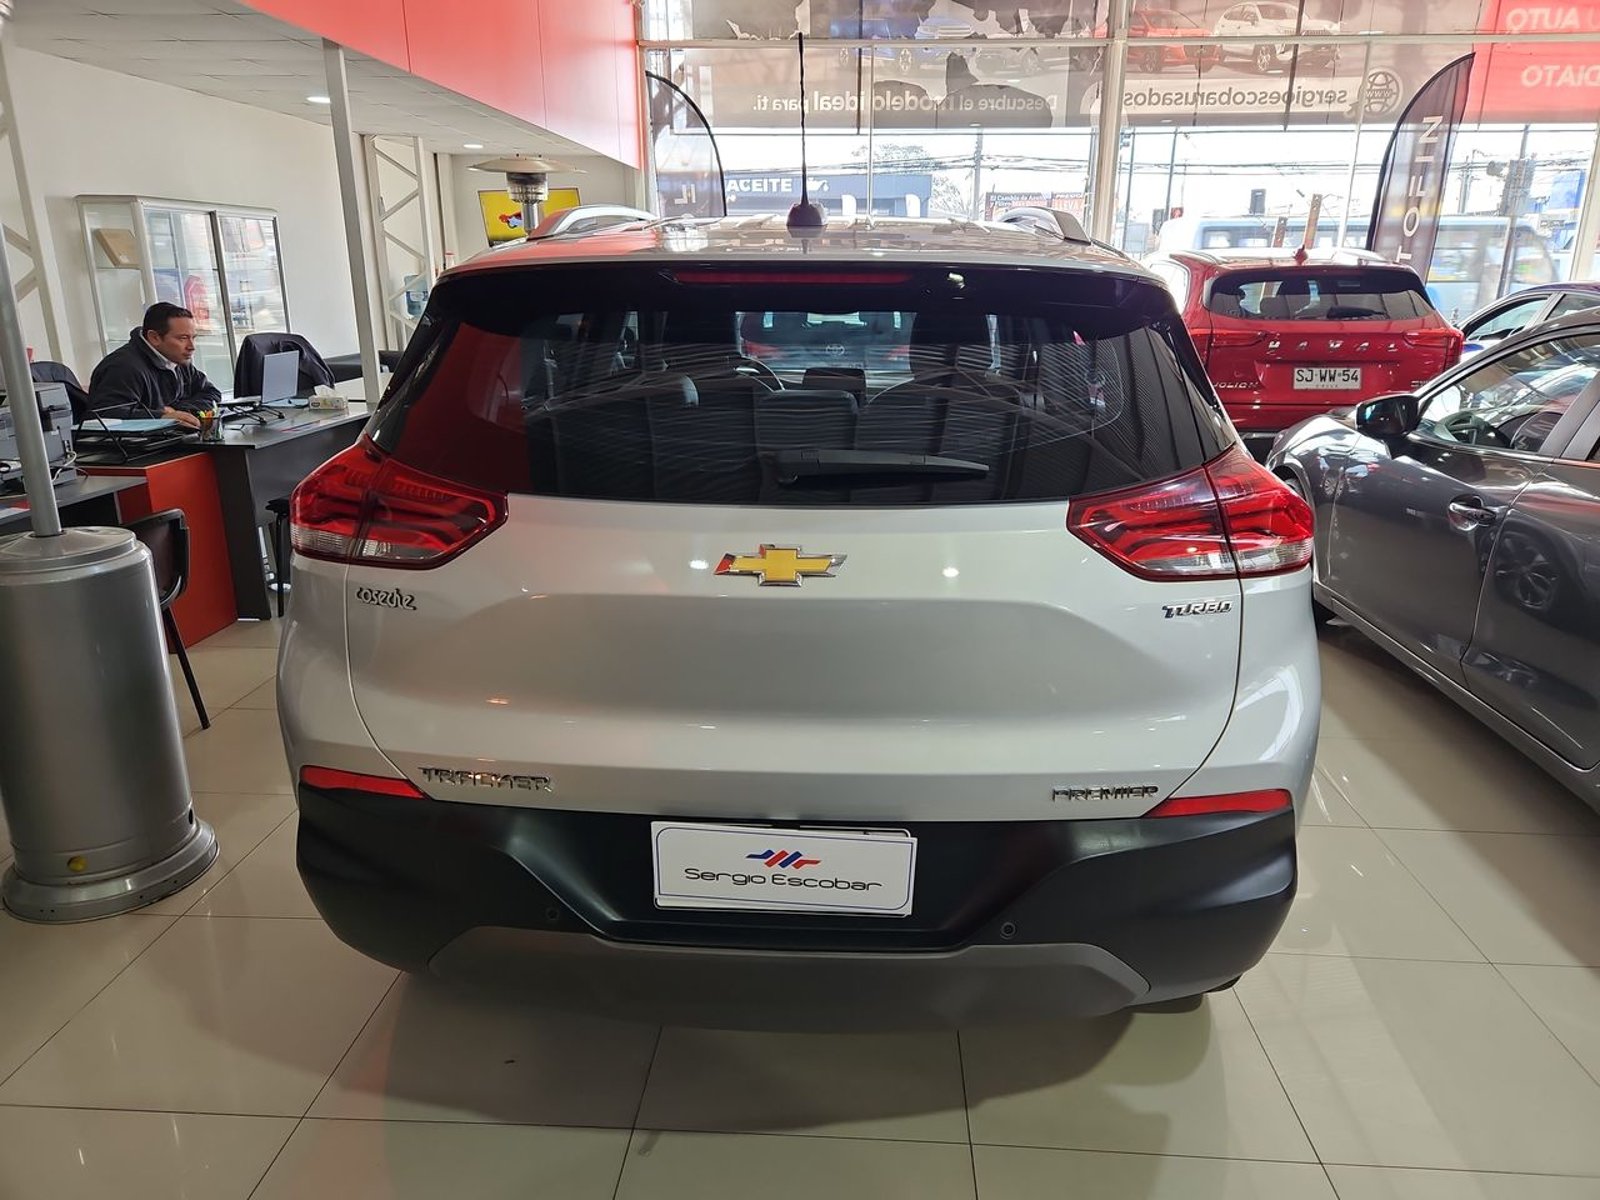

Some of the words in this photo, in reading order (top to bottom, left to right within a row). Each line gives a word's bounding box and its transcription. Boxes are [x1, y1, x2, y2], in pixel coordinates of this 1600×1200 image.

[725, 178, 792, 192] ACEITE
[1161, 598, 1234, 618] TURBO
[417, 766, 553, 793] TRACKER
[1051, 783, 1160, 802] PREMIER
[684, 868, 767, 886] Sergio
[771, 874, 883, 892] Escobar
